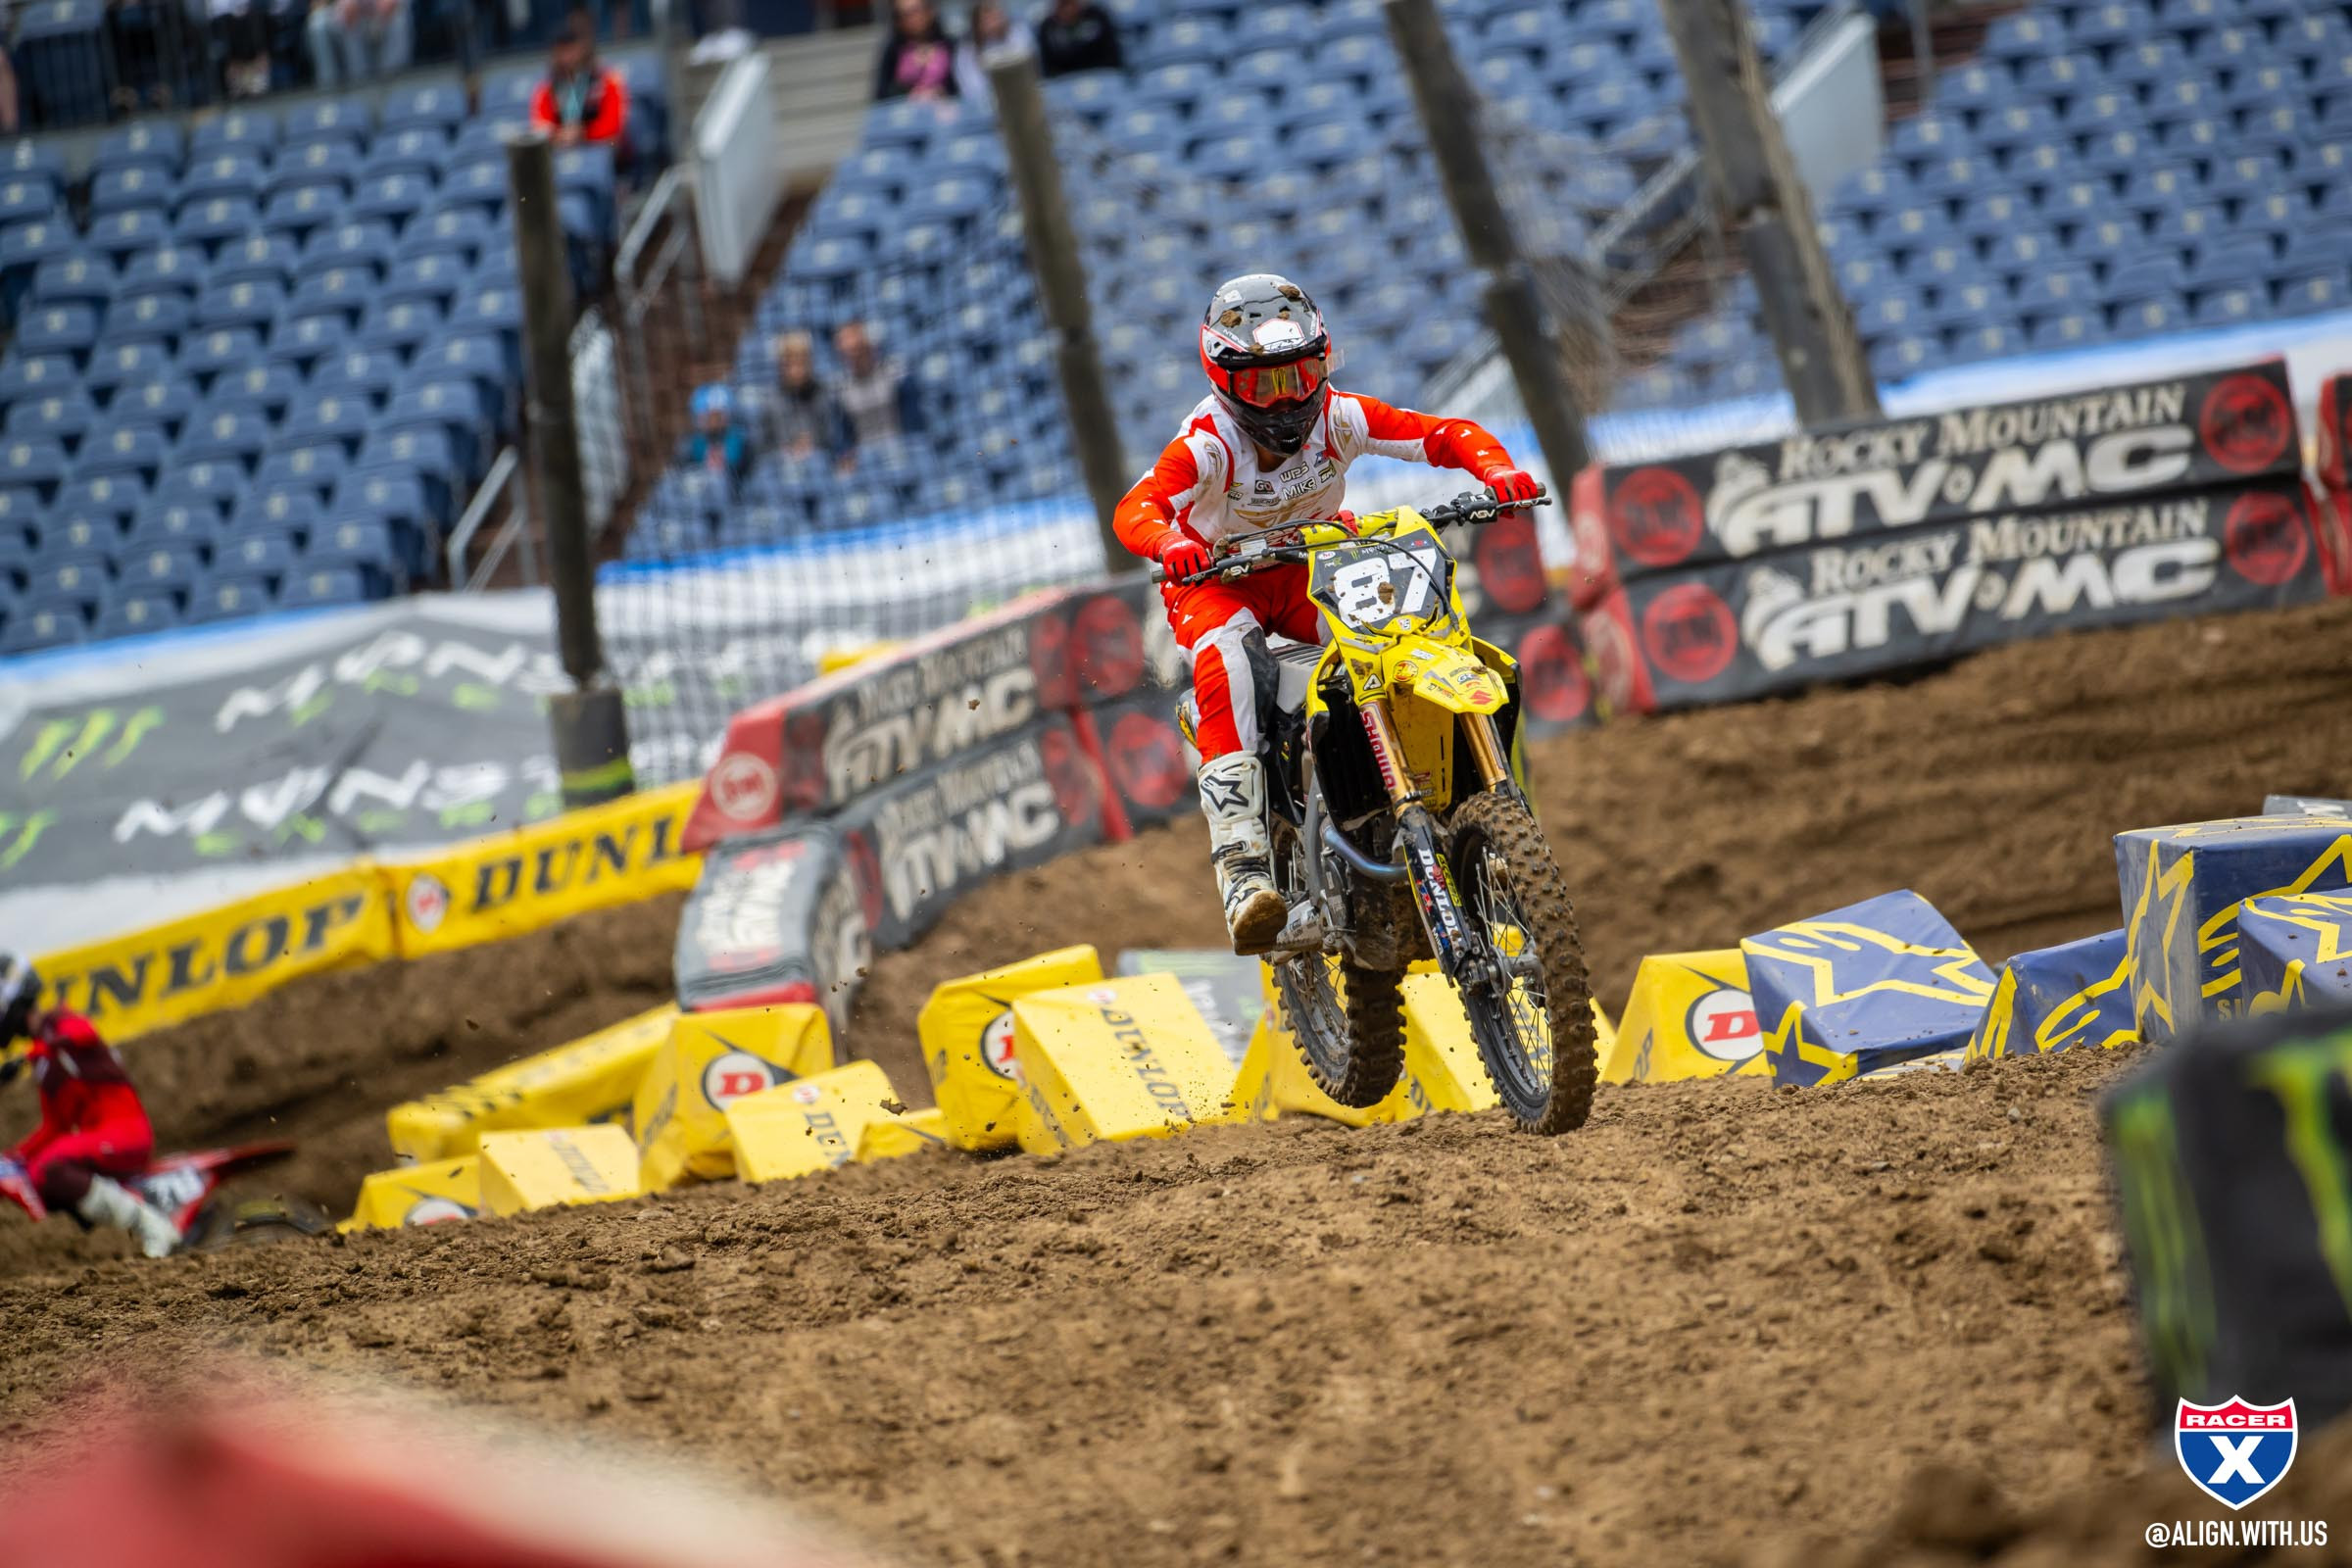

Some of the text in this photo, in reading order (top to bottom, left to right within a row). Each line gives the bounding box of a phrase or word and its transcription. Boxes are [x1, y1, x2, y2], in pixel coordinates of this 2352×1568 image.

[1779, 423, 1928, 480] ROCKY
[1937, 385, 2186, 456] MOUNTAIN
[1469, 510, 1495, 519] ASV
[1810, 532, 1959, 592] ROCKY
[1967, 497, 2210, 563] MOUNTAIN
[1224, 564, 1250, 577] SV
[1334, 548, 1438, 628] 87
[472, 815, 689, 913] DUNL
[1418, 849, 1461, 943] DUNLO
[53, 892, 366, 1016] NLOP
[1704, 1010, 1760, 1043] D
[806, 1112, 853, 1168] DUN
